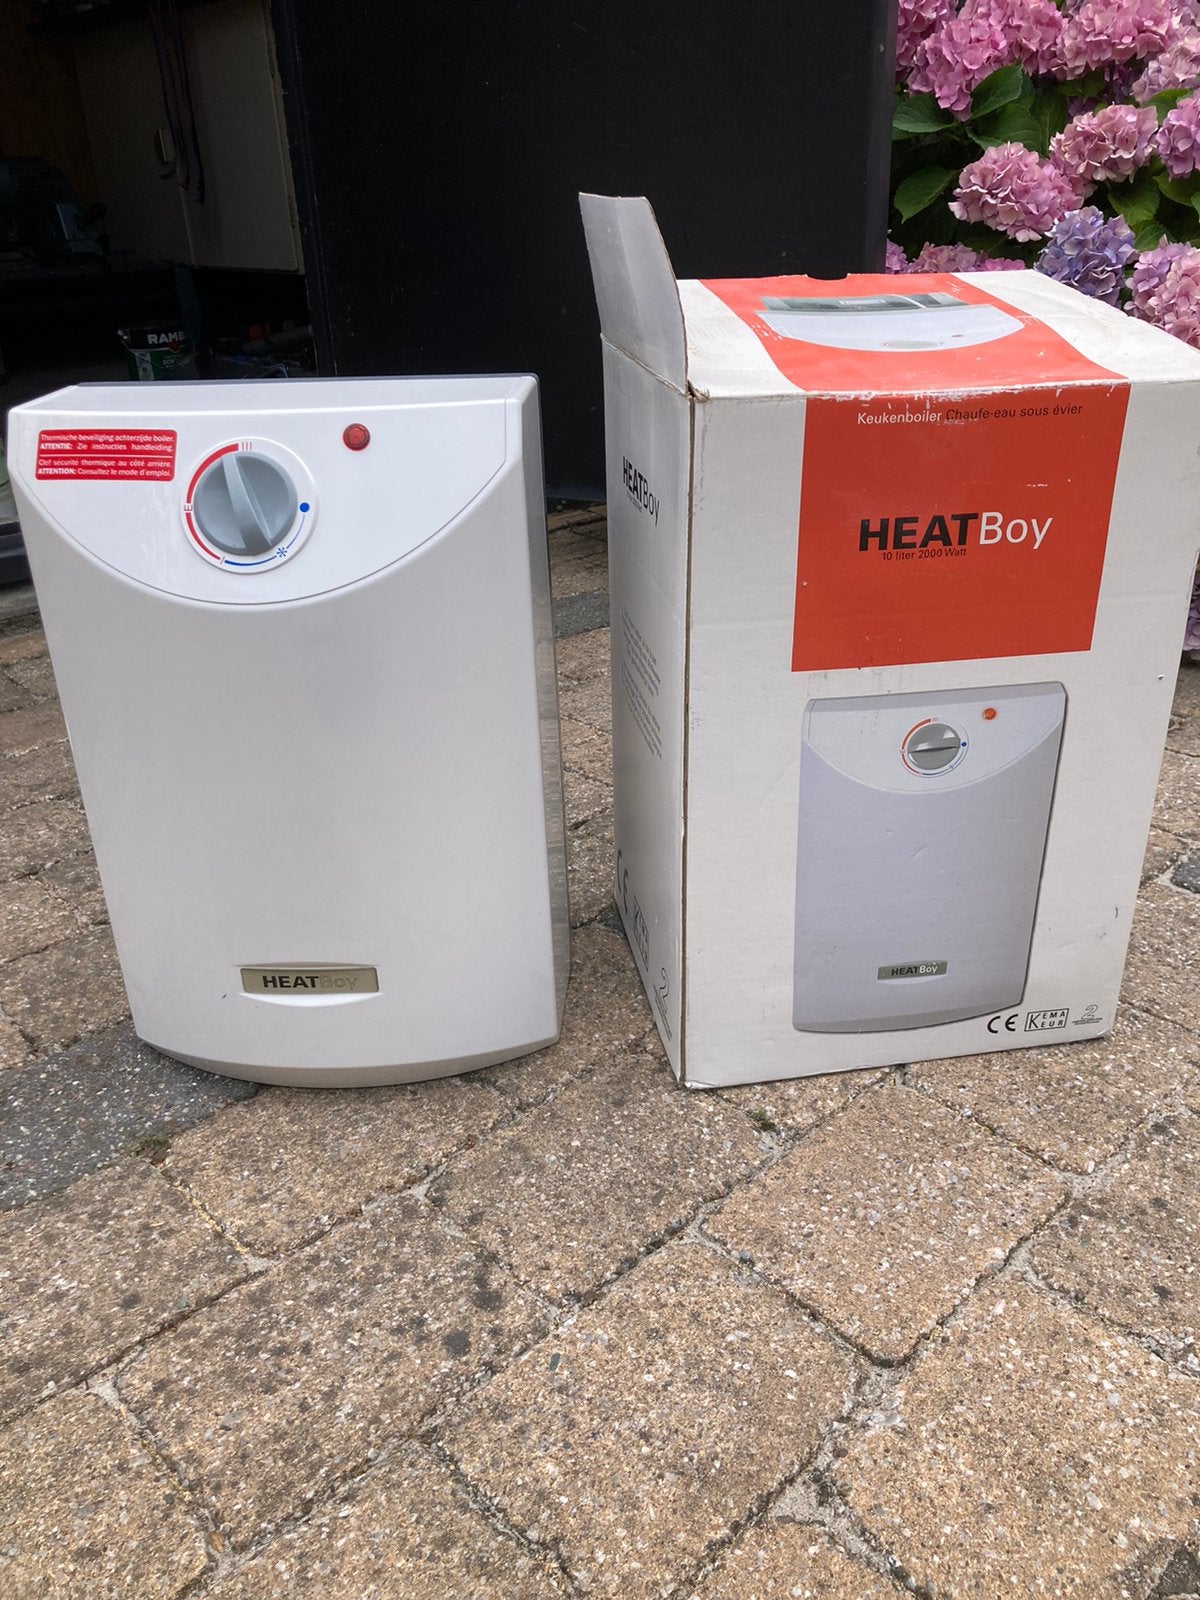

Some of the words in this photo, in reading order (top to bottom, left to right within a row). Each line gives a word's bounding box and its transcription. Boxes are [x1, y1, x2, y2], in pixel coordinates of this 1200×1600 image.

[857, 410, 942, 425] Keukenboiler
[946, 408, 1016, 420] Chaufe-eau
[1020, 406, 1049, 417] sous
[1052, 403, 1083, 415] évier
[41, 433, 78, 441] Thermische
[78, 434, 114, 443] beveiliging
[114, 434, 152, 443] achterzijde
[153, 434, 174, 443] boiler.
[41, 442, 73, 450] ATTENTIE:
[77, 442, 88, 450] Zie
[38, 458, 51, 466] Clef
[81, 459, 116, 468] thermique
[129, 459, 145, 467] côté
[38, 467, 76, 475] ATTENTION:
[77, 467, 109, 475] Consultez
[111, 468, 118, 476] le
[118, 468, 138, 476] mode
[622, 455, 660, 528] HEATBoy
[858, 511, 1053, 551] HEATBoy
[882, 551, 893, 560] 10
[895, 550, 916, 560] liter
[918, 548, 942, 559] 2000
[944, 547, 967, 557] Watt
[890, 964, 938, 976] HEATBoy
[262, 975, 358, 991] HEATBoy
